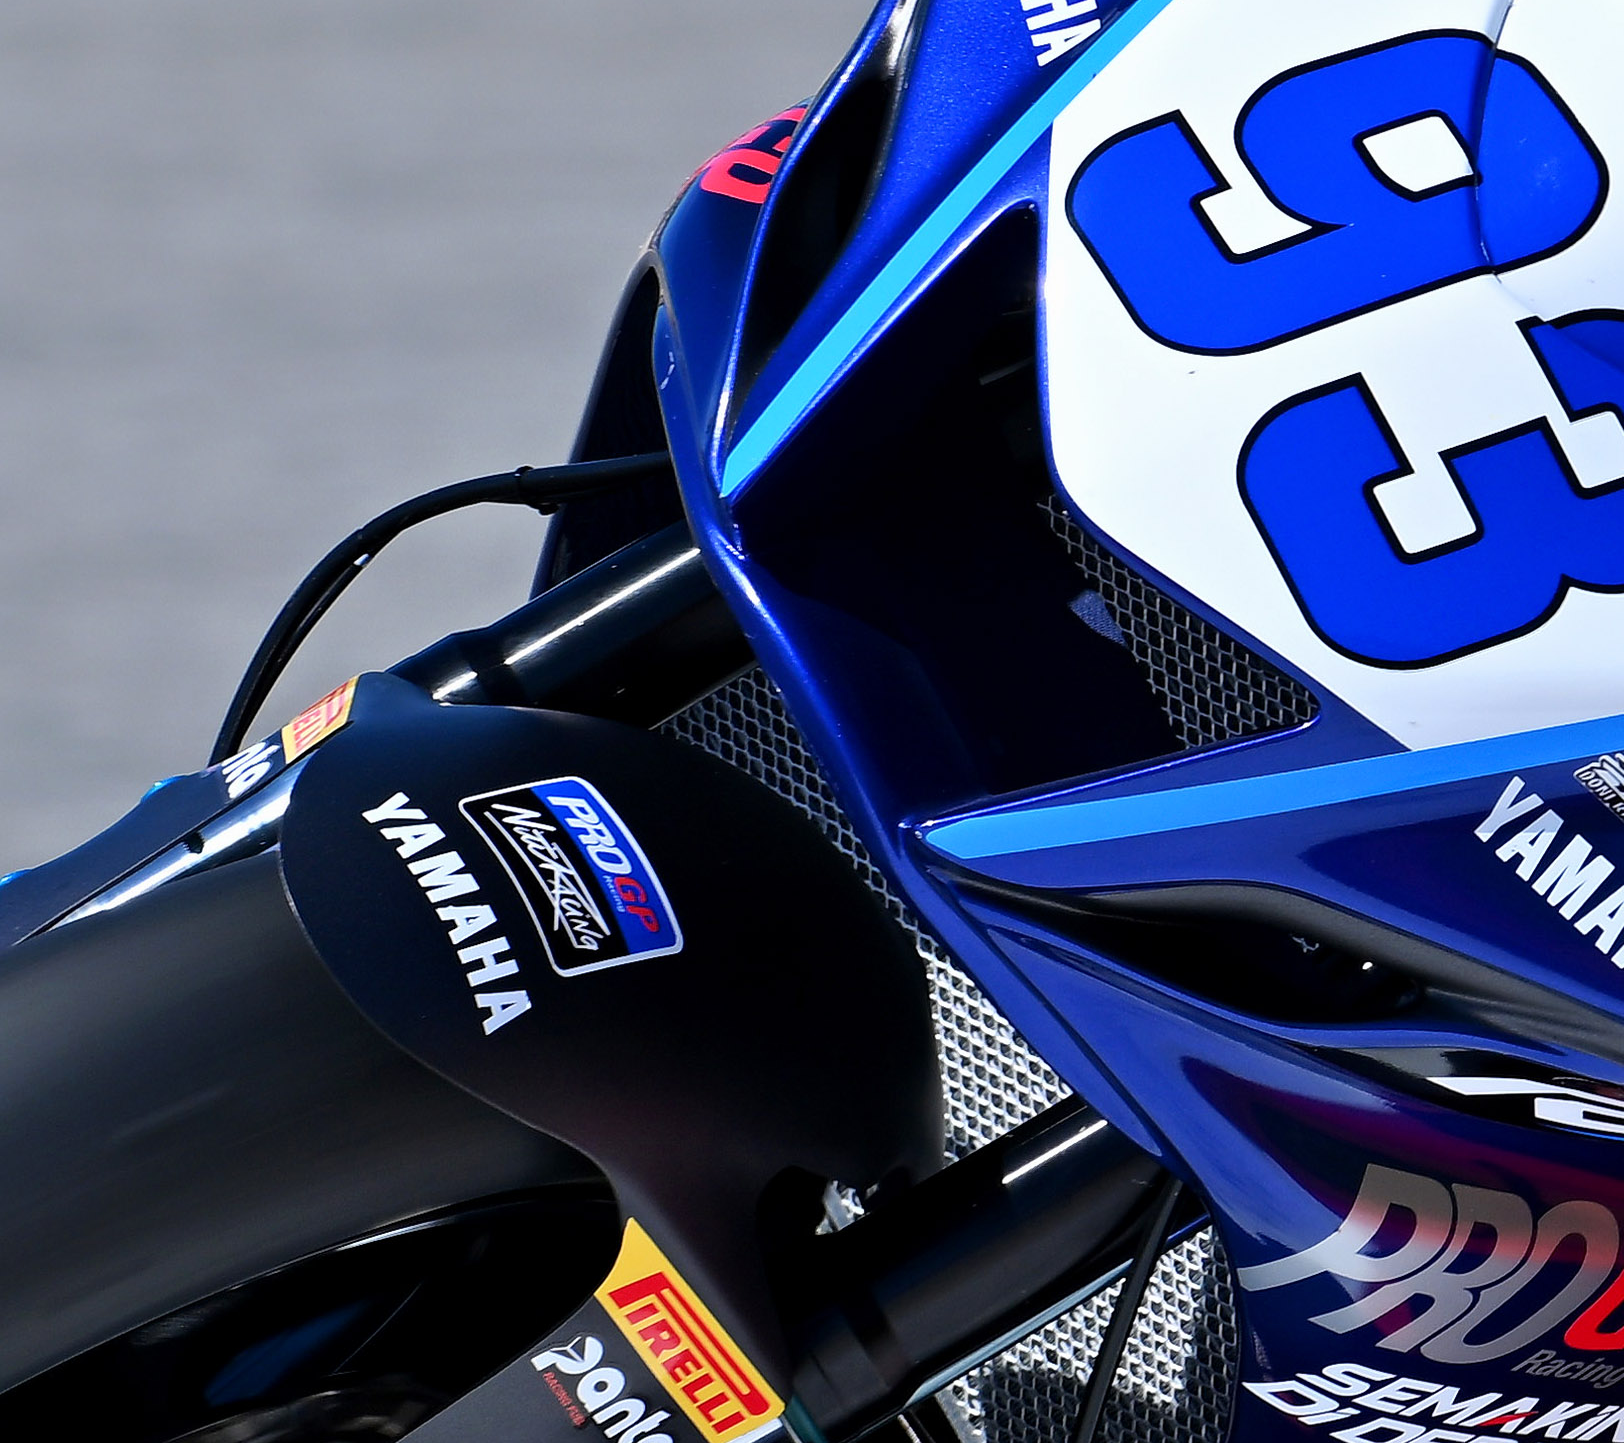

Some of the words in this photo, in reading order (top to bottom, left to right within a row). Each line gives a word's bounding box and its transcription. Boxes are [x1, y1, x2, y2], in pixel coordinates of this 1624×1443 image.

[1579, 769, 1616, 806] DONI
[361, 790, 533, 1037] YAMAHA
[546, 794, 660, 932] PROGP
[608, 1271, 771, 1434] PIRELLI
